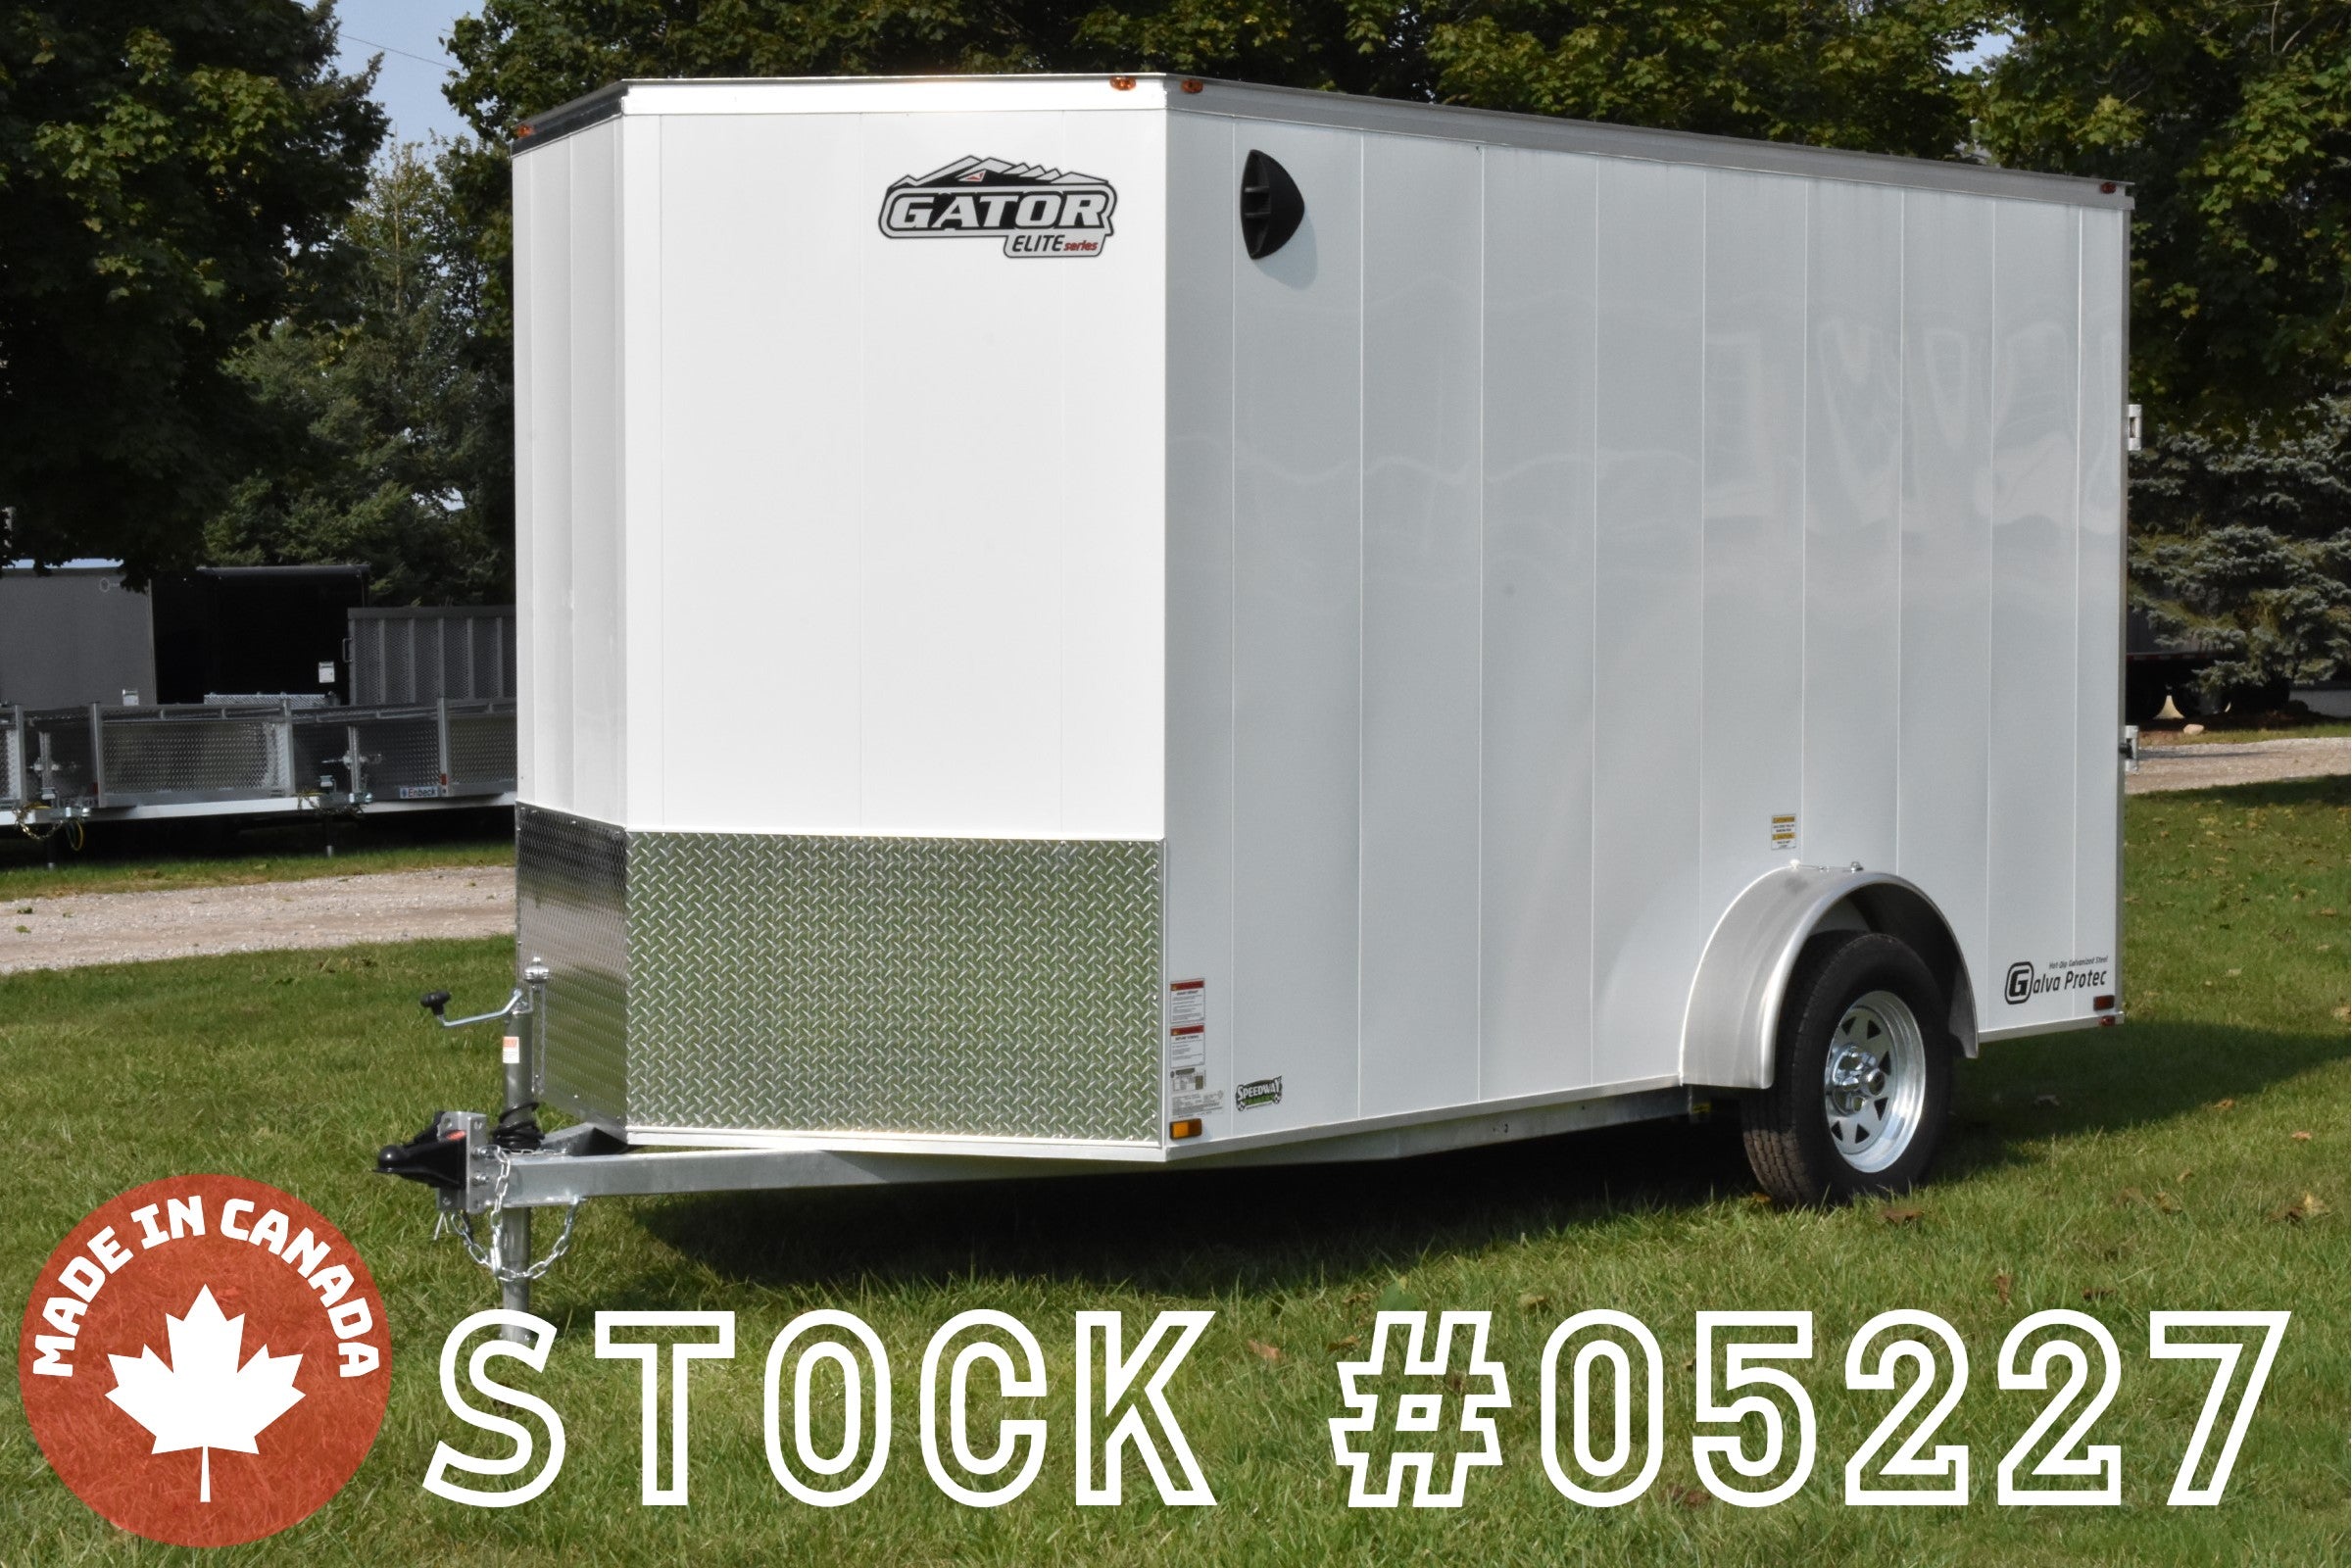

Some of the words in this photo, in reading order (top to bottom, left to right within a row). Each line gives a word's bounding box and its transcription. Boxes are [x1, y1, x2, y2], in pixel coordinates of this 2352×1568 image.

[888, 193, 1105, 229] GATOR
[1011, 234, 1065, 253] ELITE
[1063, 239, 1099, 252] series
[2069, 956, 2095, 967] Galvanized
[2095, 955, 2109, 963] Steel
[2006, 966, 2061, 1001] Galva
[2064, 969, 2107, 991] Protec
[1236, 1076, 1282, 1102] SPEEDWAY
